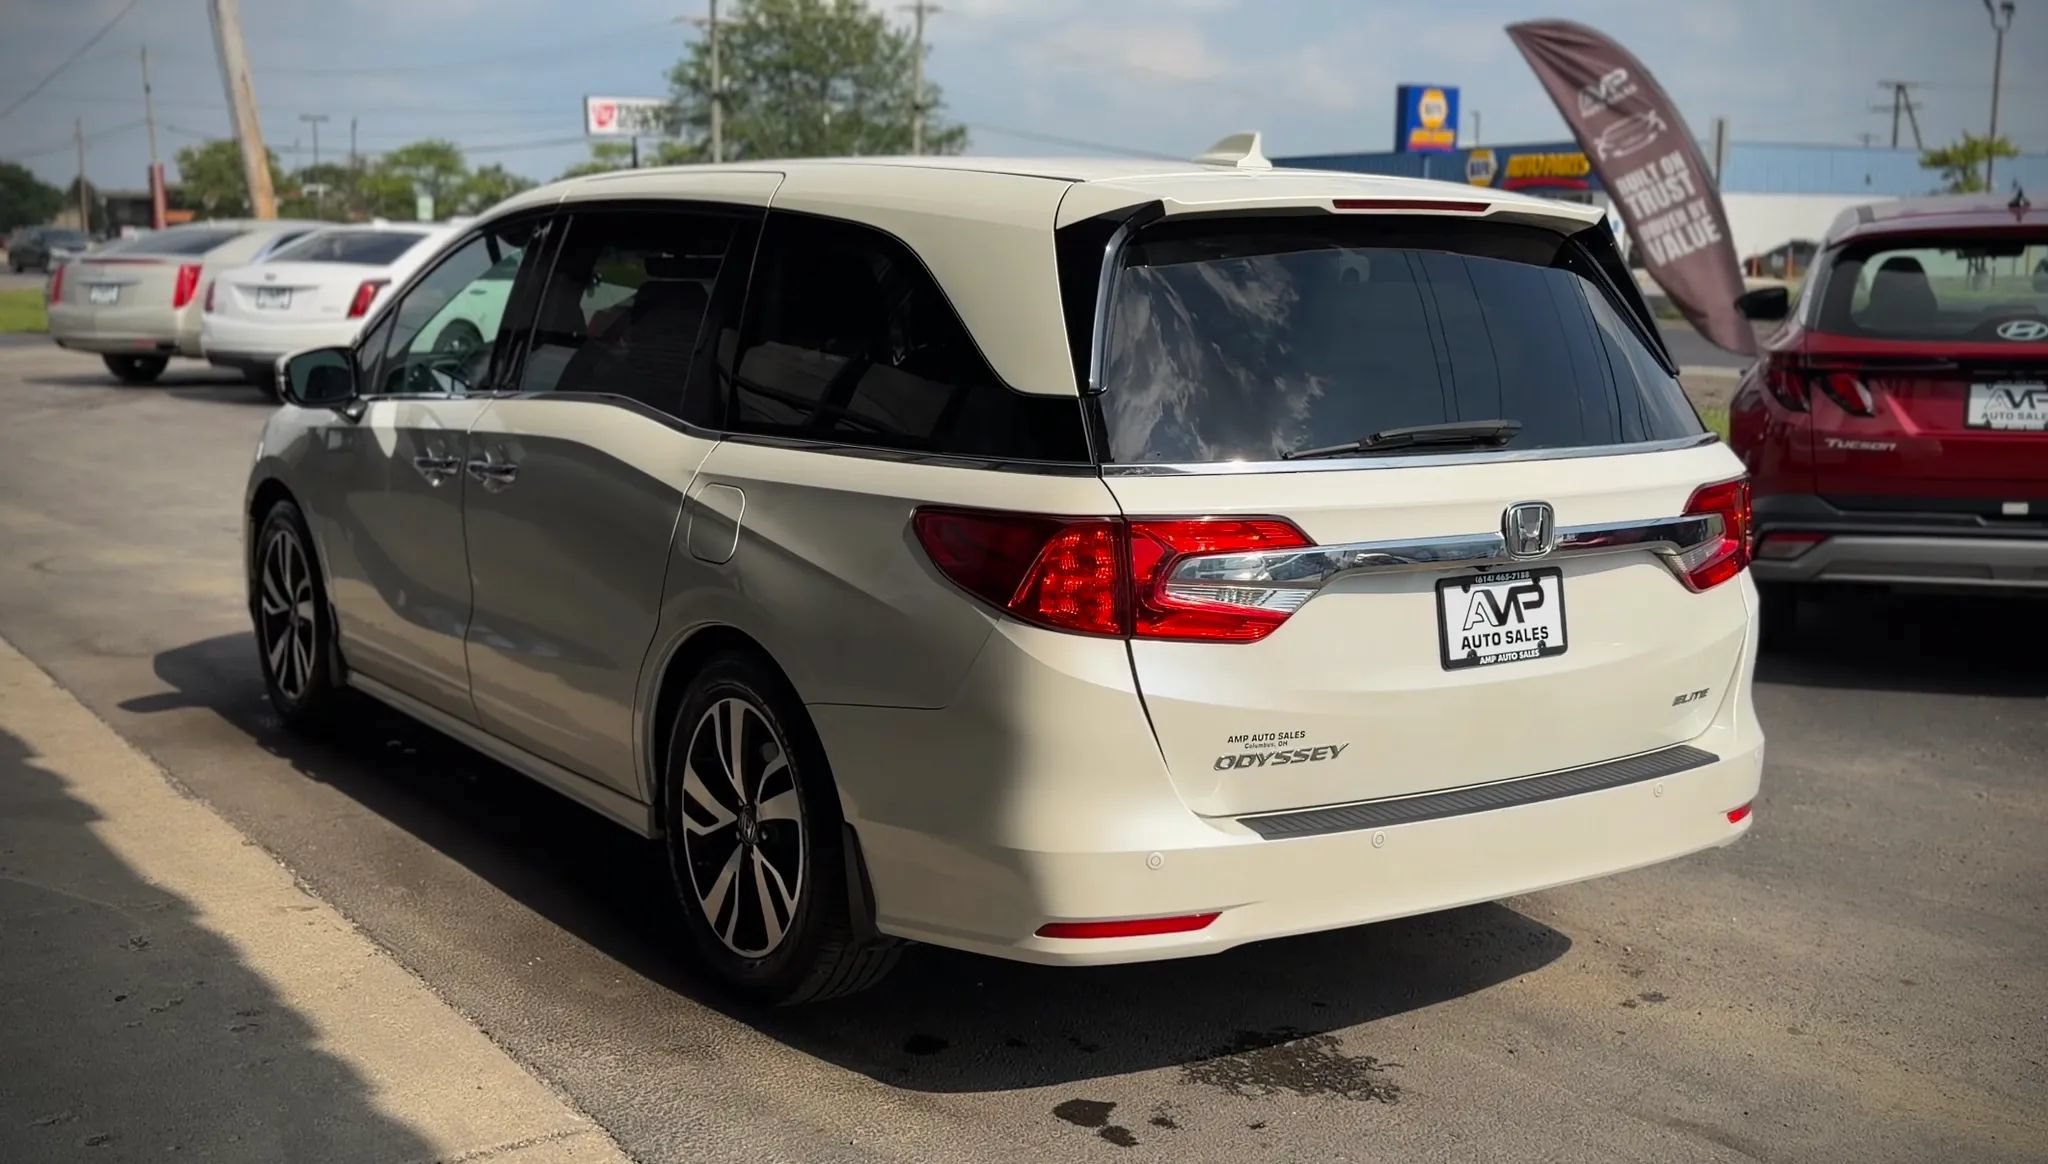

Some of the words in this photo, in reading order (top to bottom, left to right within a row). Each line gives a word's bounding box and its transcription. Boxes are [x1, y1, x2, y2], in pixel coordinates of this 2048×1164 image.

[1615, 162, 1660, 197] BUILT
[1660, 150, 1686, 175] ON
[1624, 170, 1696, 220] TRUST
[1647, 215, 1722, 267] VALUE
[1981, 411, 2014, 420] AUTO
[1824, 437, 1896, 451] TUCSON
[1461, 632, 1501, 650] AUTO
[1505, 626, 1549, 645] SALES
[1479, 656, 1497, 665] AMP
[1497, 653, 1518, 662] AUTO
[1519, 649, 1540, 658] SALES
[1672, 687, 1710, 707] ELITE
[1227, 734, 1249, 744] AMP
[1251, 732, 1276, 742] AUTO
[1278, 730, 1306, 740] SALES
[1213, 743, 1350, 771] ODYSSEY
